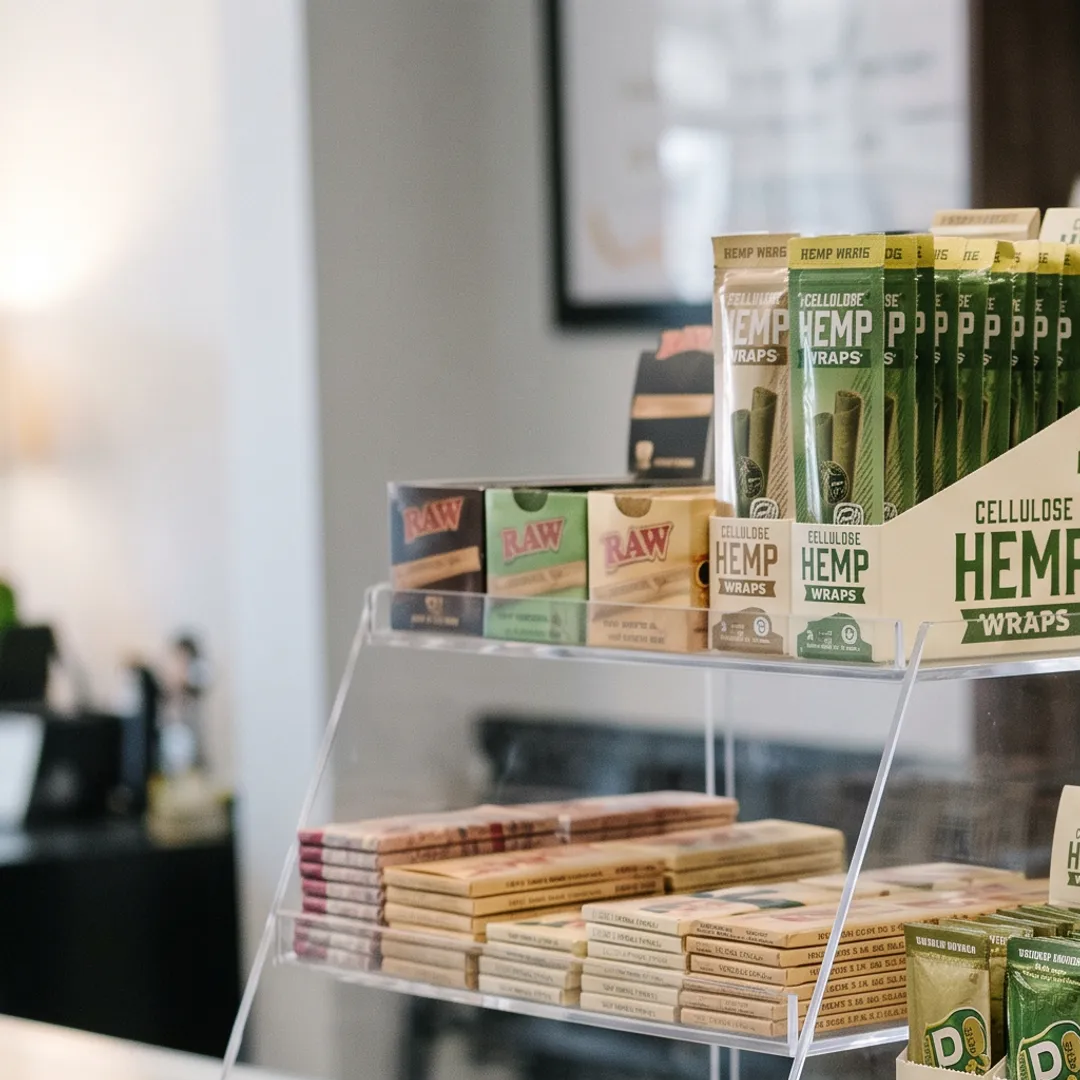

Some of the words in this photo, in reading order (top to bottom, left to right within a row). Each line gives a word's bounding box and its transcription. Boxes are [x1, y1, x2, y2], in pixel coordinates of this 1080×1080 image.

[724, 247, 753, 259] HEMP
[801, 248, 832, 260] HEMP
[799, 310, 873, 348] HEMP
[403, 497, 464, 545] RAW
[975, 498, 1073, 524] CELLULOSE
[502, 517, 564, 562] RAW
[603, 521, 673, 573] RAW
[716, 541, 778, 576] HEMP
[802, 547, 869, 583] HEMP
[724, 582, 766, 595] WRAPS
[811, 588, 856, 601] WRAPS
[979, 609, 1070, 636] WRAPS
